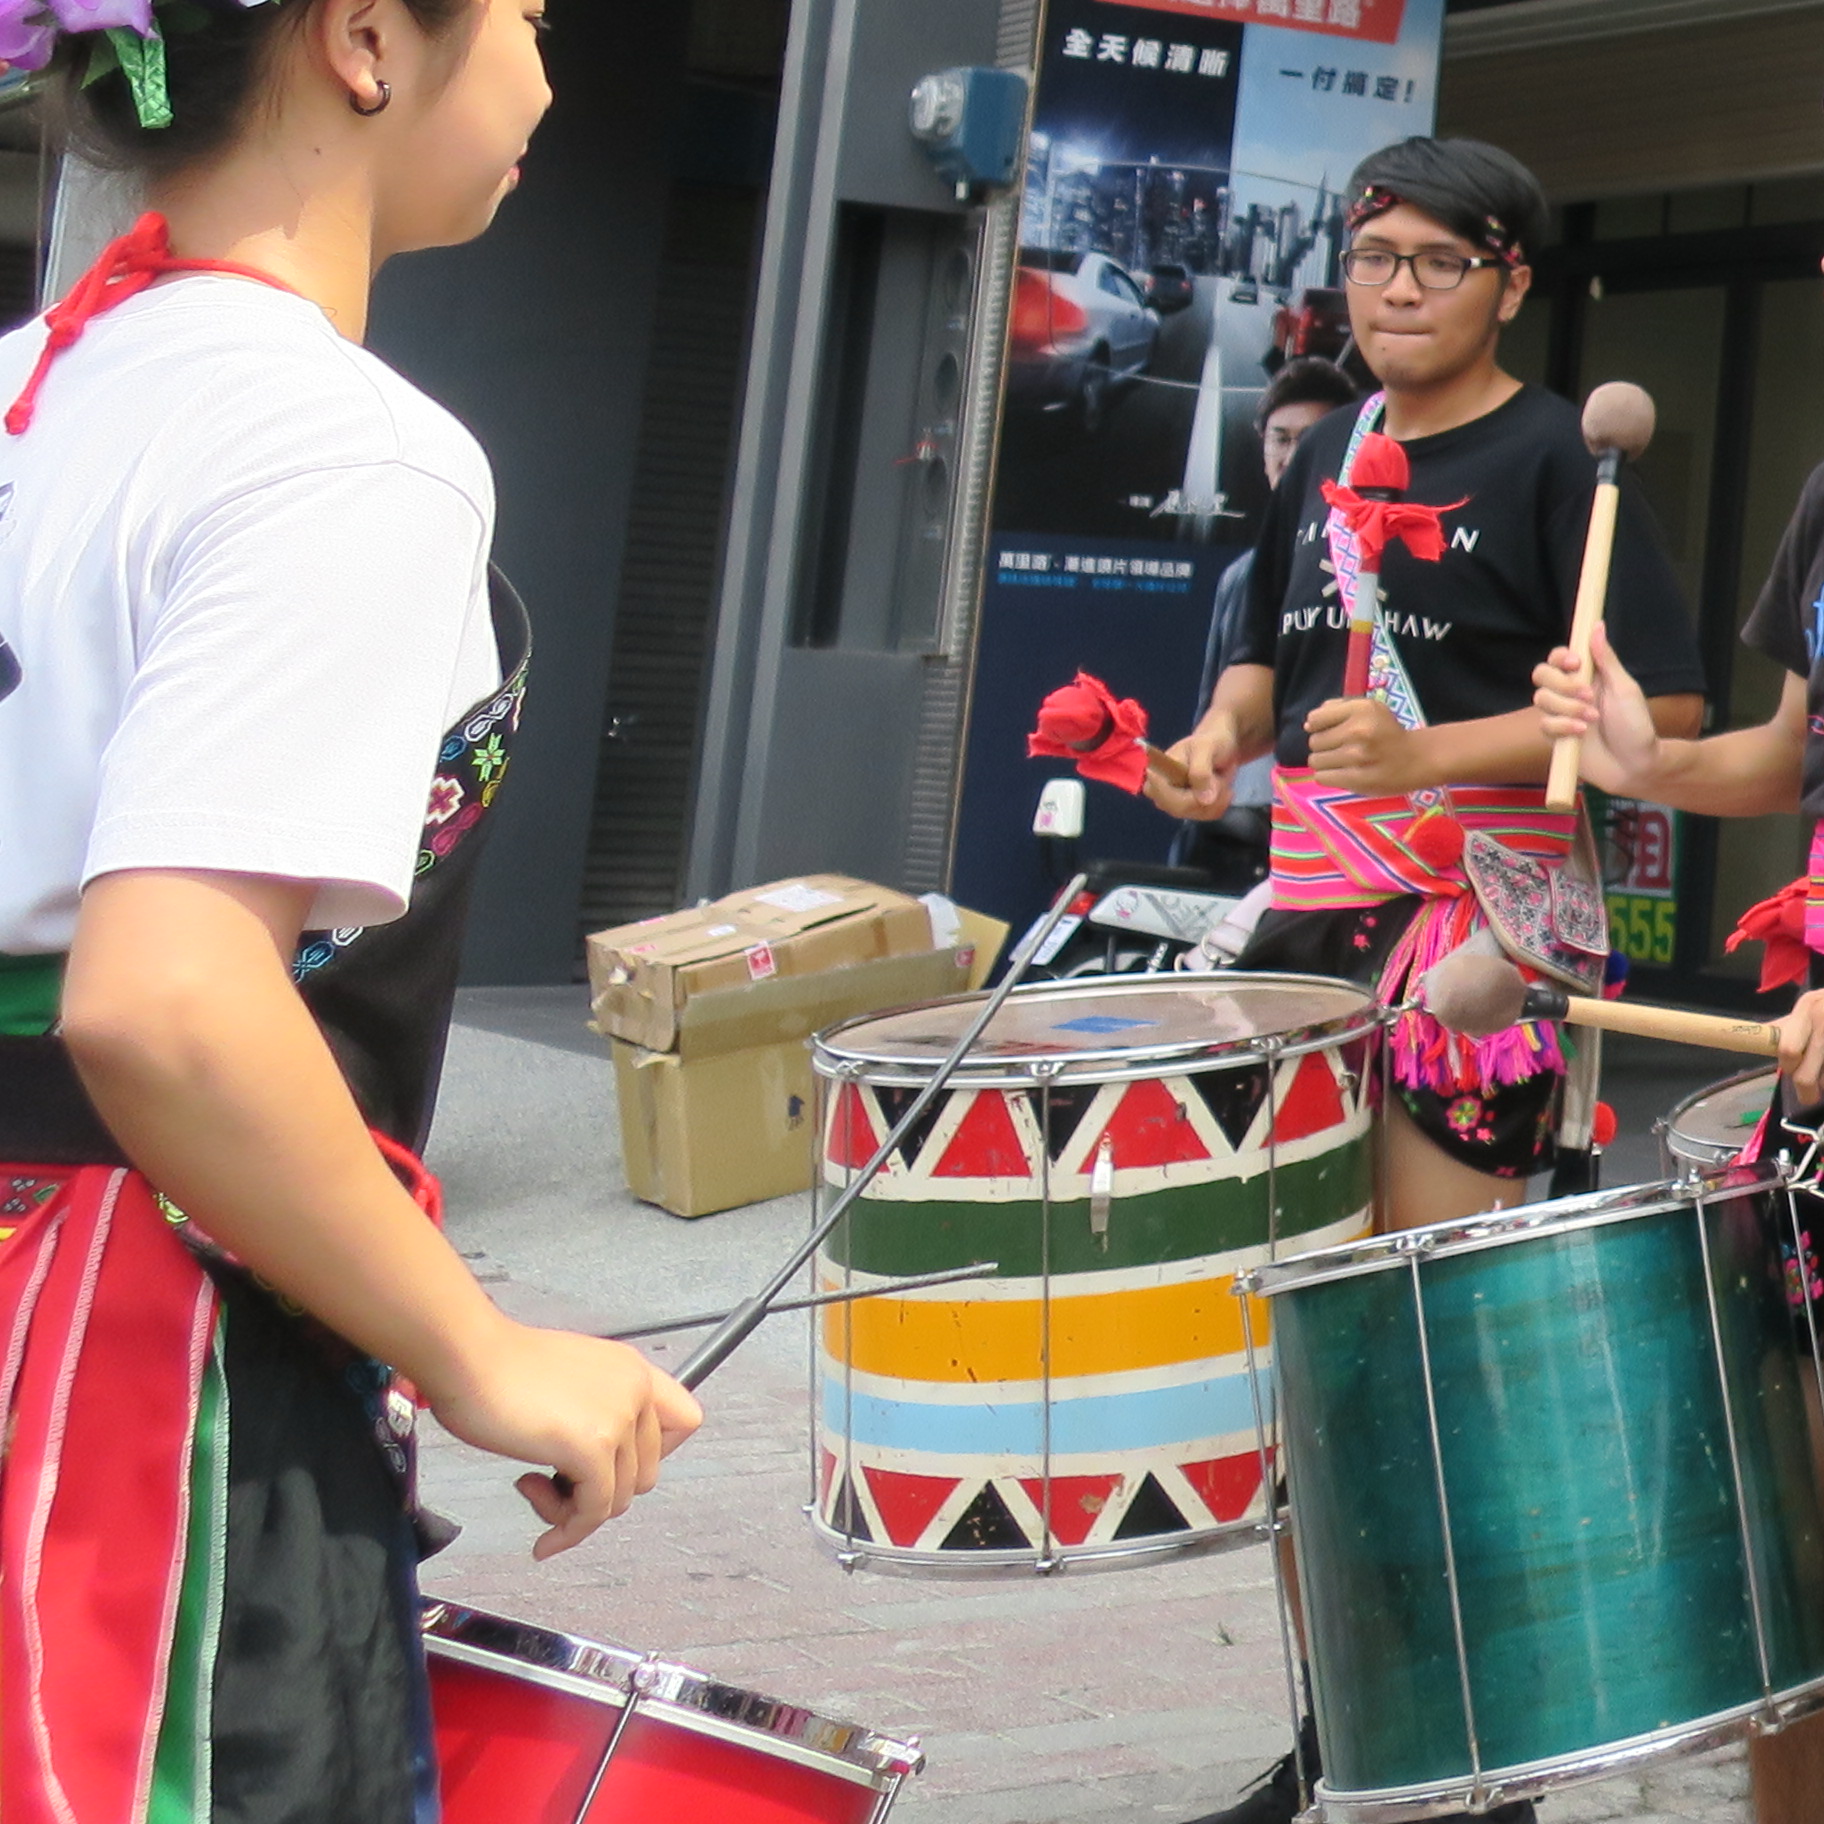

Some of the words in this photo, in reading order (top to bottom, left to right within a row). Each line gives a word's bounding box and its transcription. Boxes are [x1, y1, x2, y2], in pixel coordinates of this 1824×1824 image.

[1061, 28, 1231, 78] 全天候清晰
